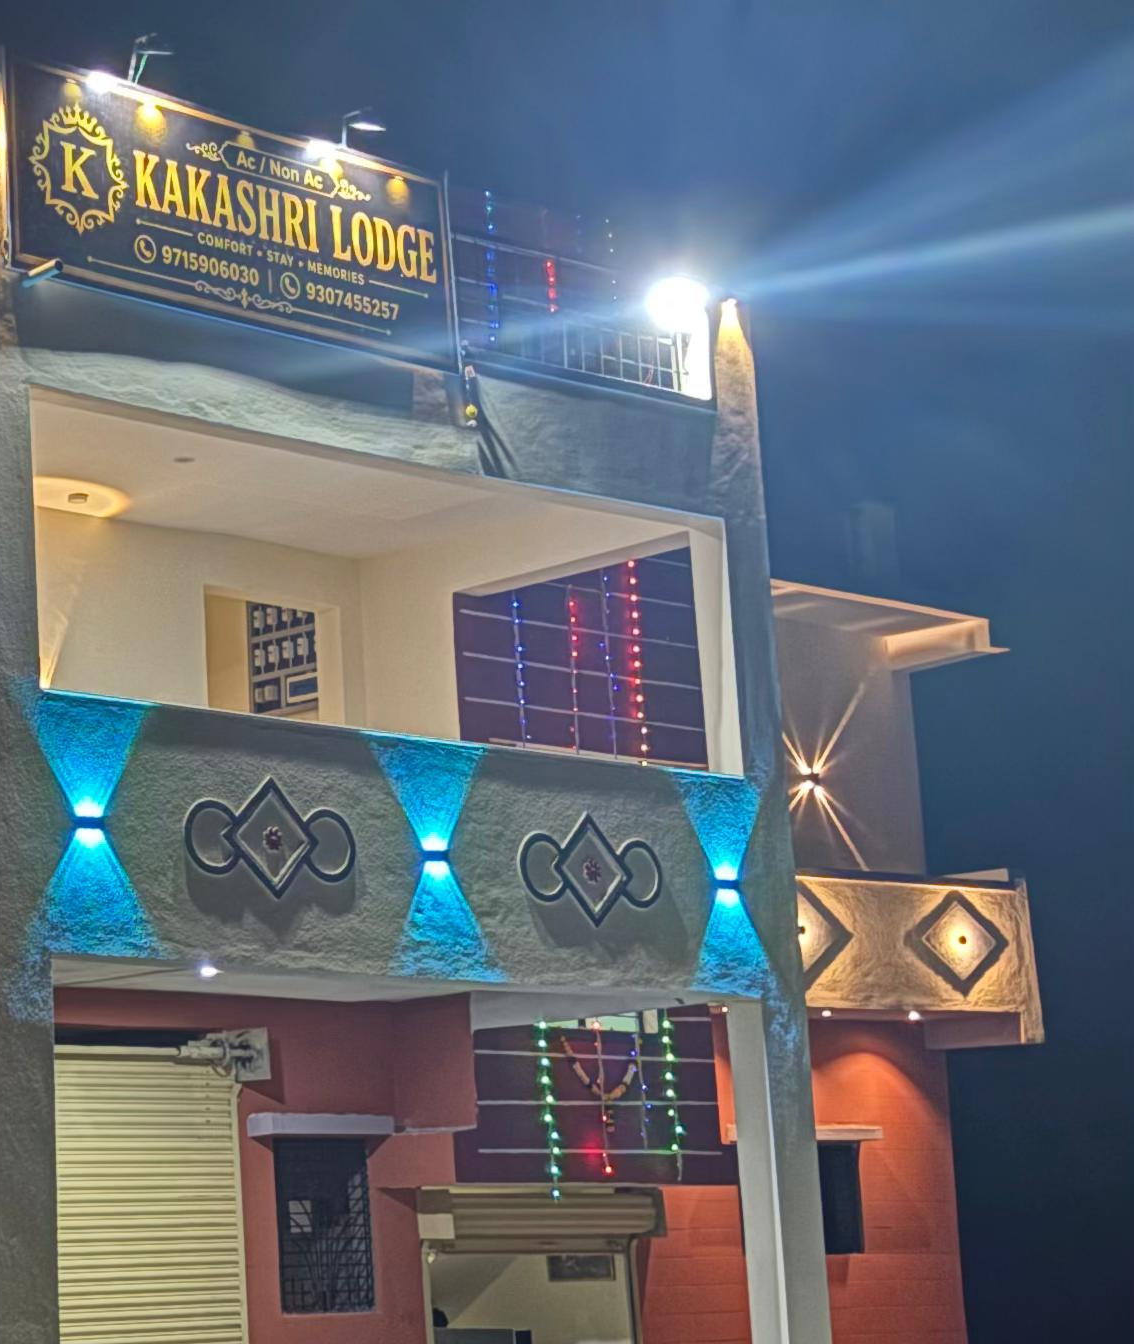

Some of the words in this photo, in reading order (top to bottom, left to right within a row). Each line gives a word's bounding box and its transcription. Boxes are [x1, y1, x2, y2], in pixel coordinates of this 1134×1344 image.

[60, 140, 99, 200] K
[237, 151, 256, 170] Ac
[259, 158, 265, 173] /
[270, 159, 299, 182] Non
[304, 168, 323, 190] Ac
[132, 149, 319, 253] KAKASHRI
[330, 205, 437, 284] LODGE
[162, 245, 259, 286] 9715906030
[197, 232, 254, 256] COMFORT
[266, 250, 294, 268] STAY
[307, 260, 365, 285] MEMORIES
[306, 282, 400, 321] 9307455257
